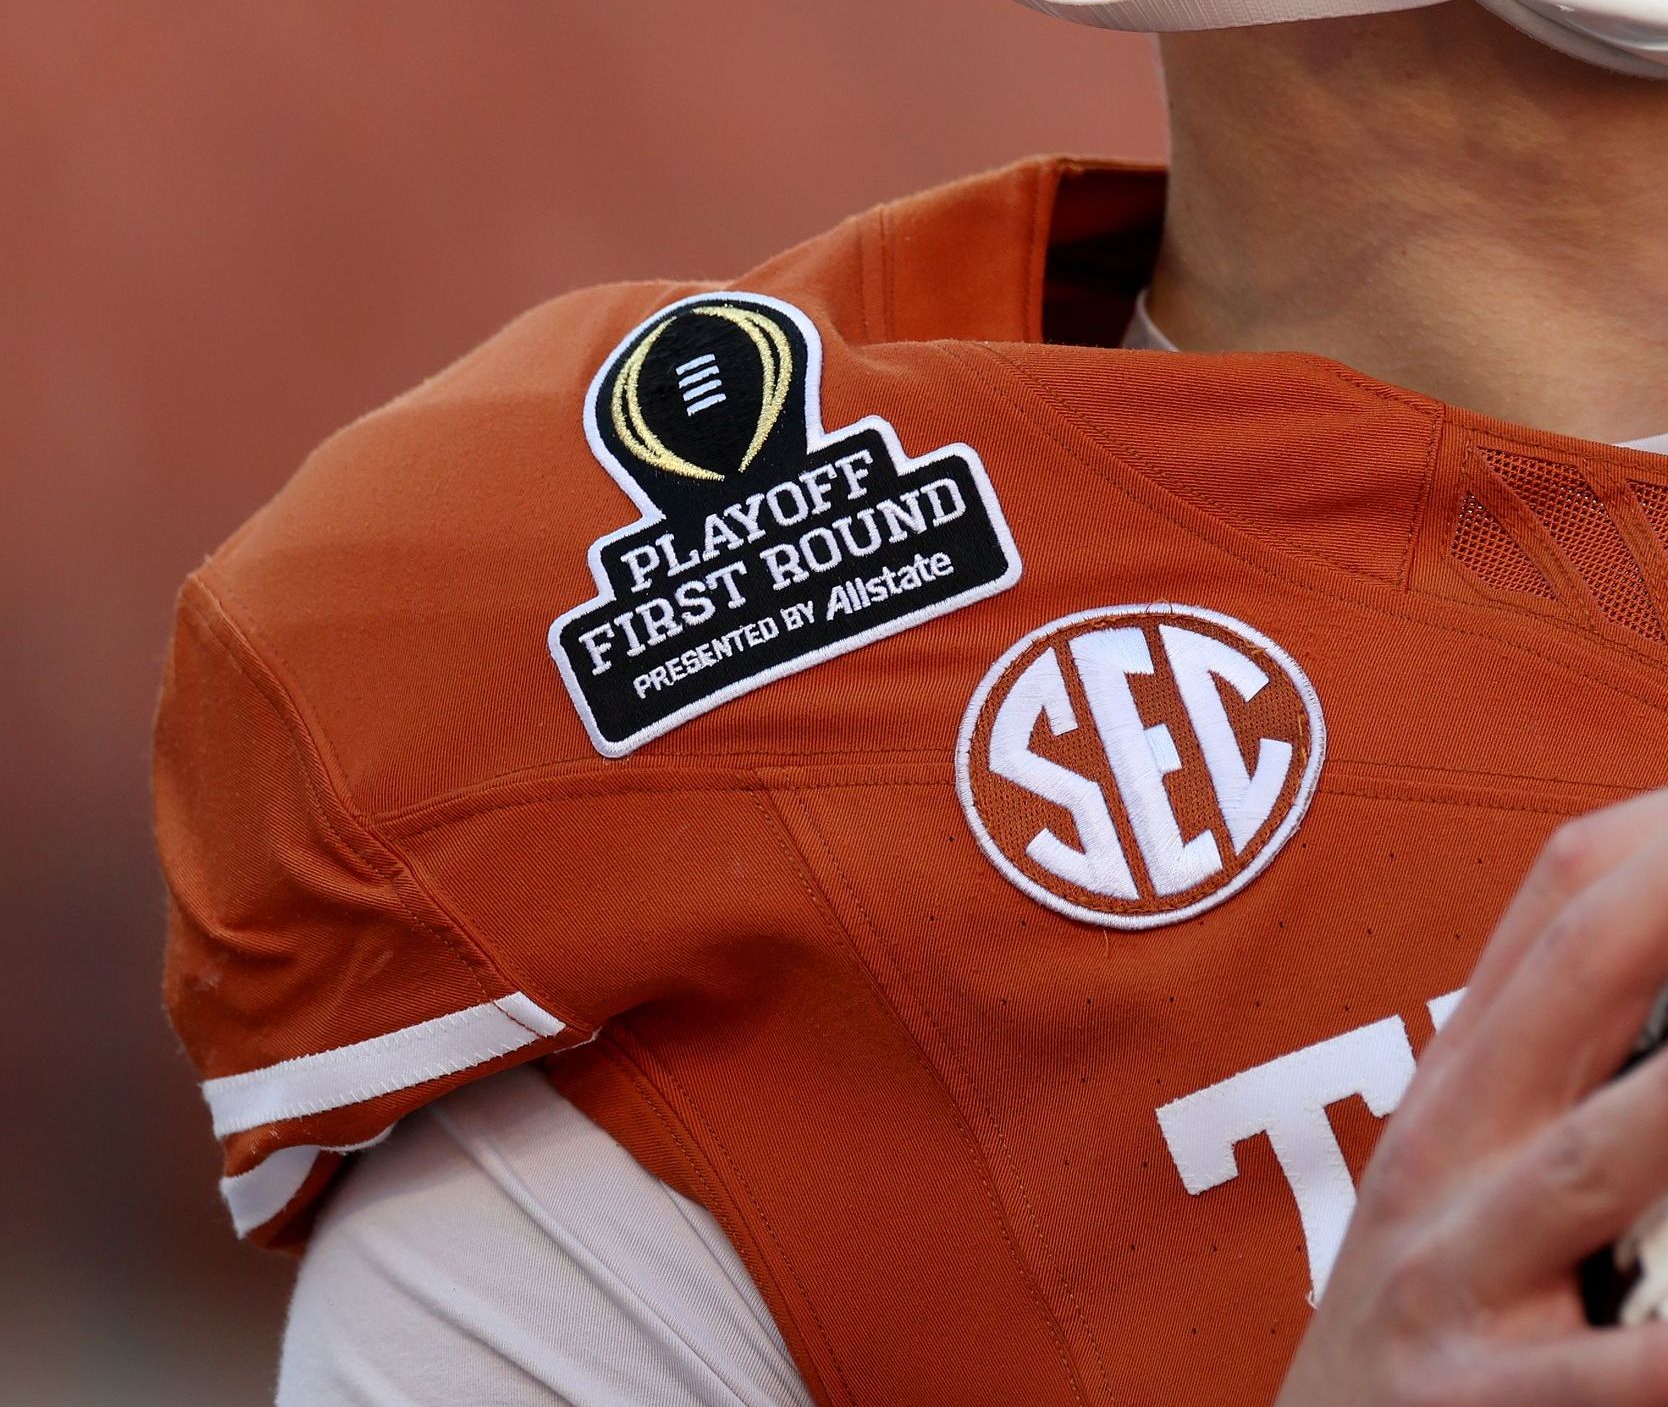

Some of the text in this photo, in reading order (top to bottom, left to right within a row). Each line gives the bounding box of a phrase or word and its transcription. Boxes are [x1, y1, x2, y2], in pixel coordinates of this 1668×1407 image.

[578, 478, 967, 676] FIRST ROUND
[620, 449, 873, 593] PLAYOFF
[633, 551, 955, 700] PRESENTED BY Allstate
[989, 624, 1293, 901] SEC
